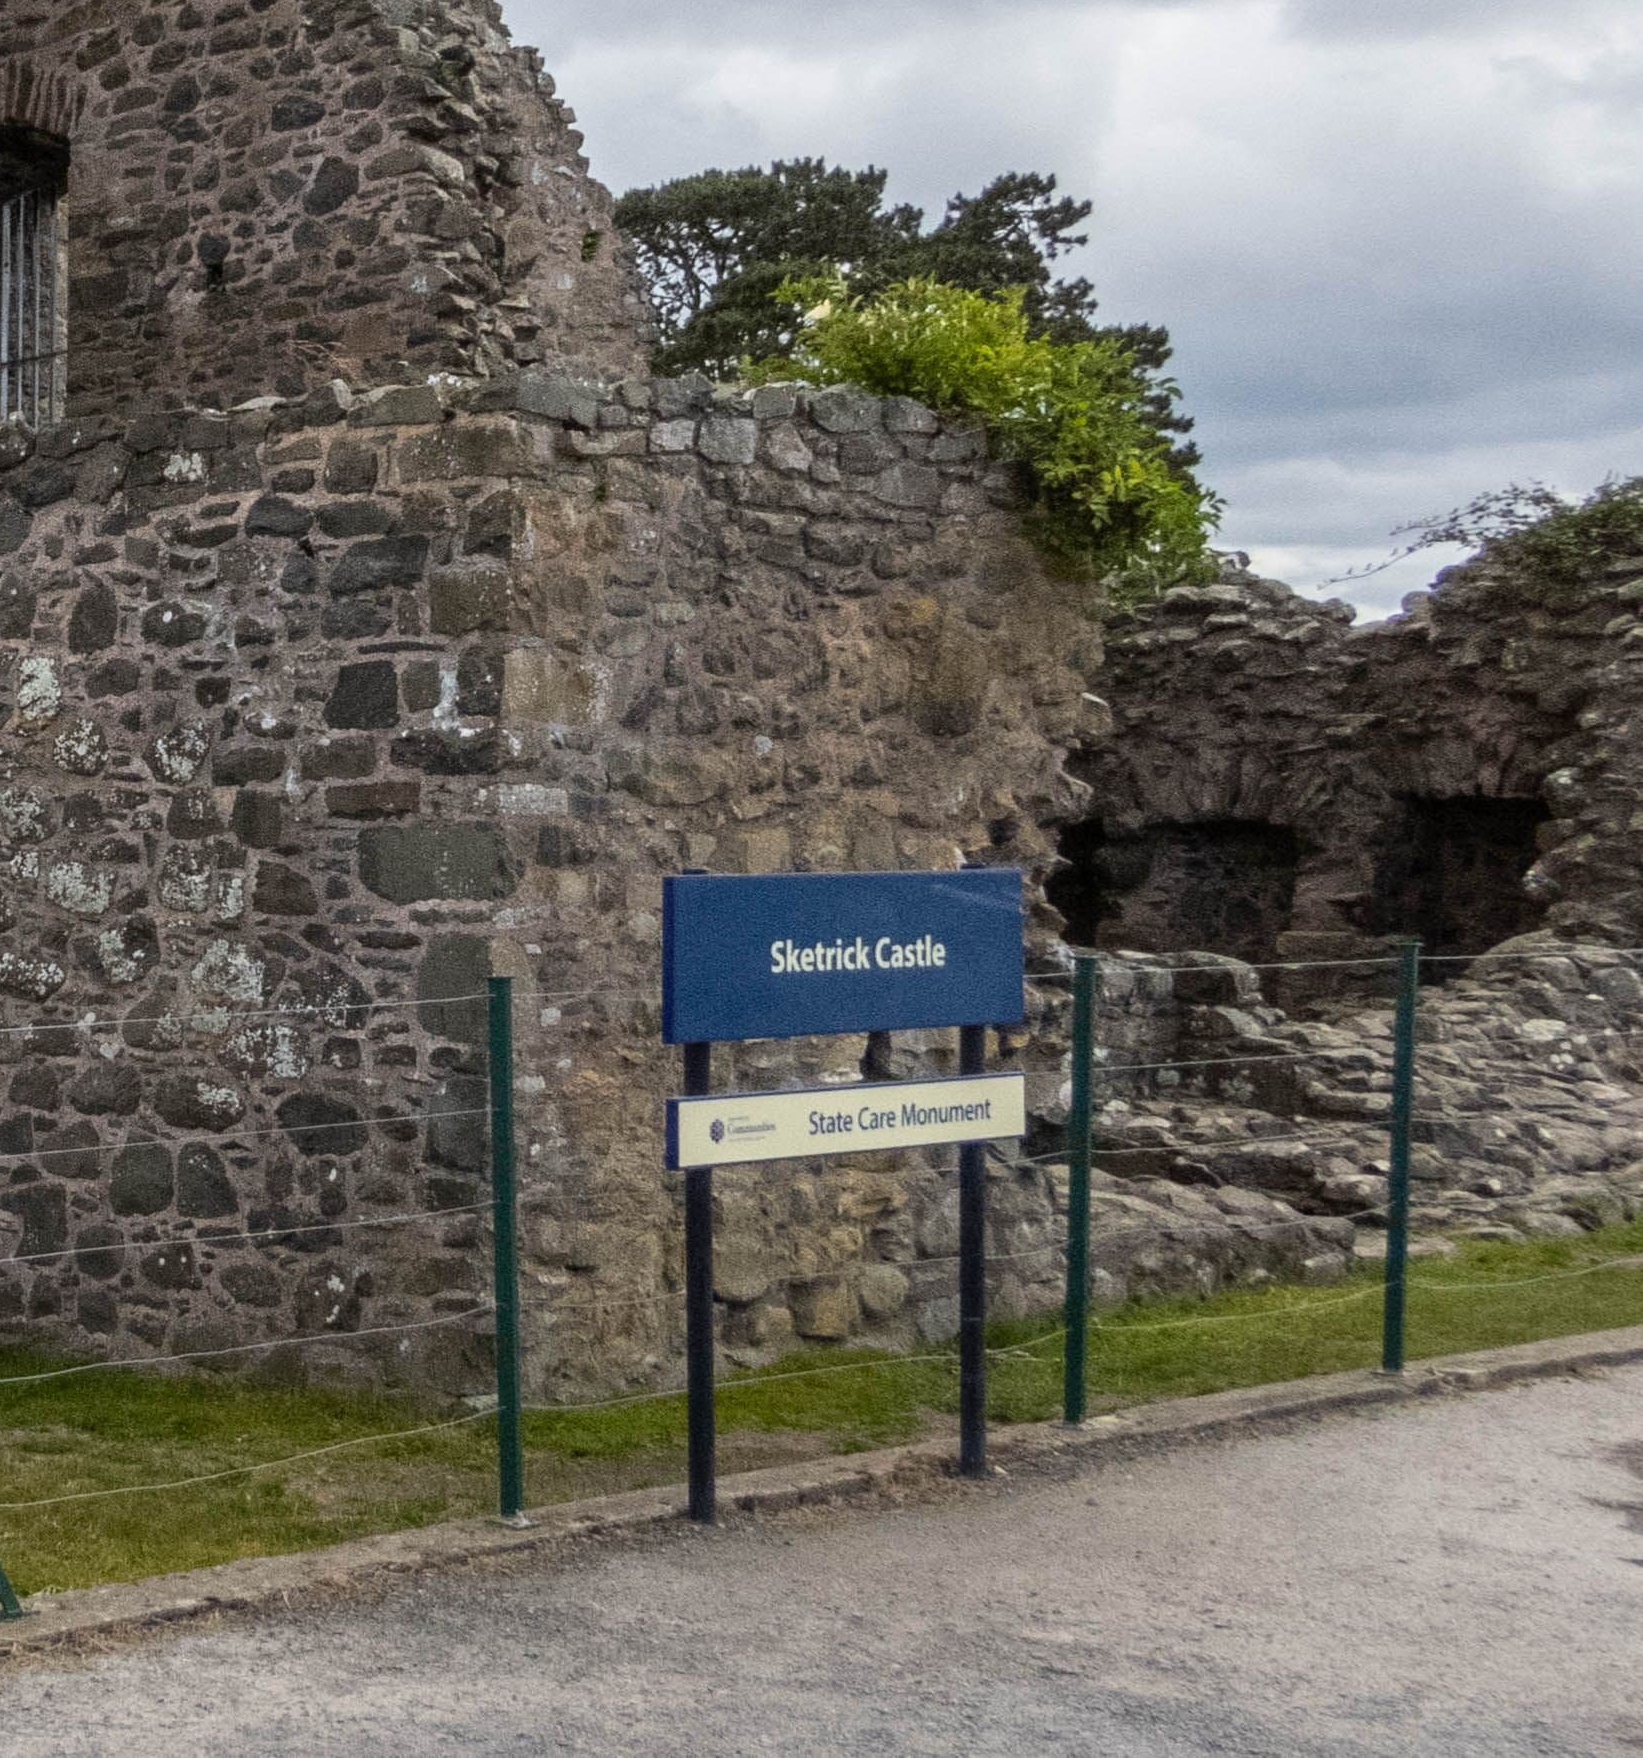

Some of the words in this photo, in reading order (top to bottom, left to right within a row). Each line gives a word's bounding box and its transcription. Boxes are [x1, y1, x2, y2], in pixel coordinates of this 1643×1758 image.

[770, 937, 871, 974] Sketrick
[874, 934, 946, 970] Castle
[808, 1110, 854, 1135] State
[857, 1106, 896, 1130] Care
[900, 1099, 992, 1126] Monument
